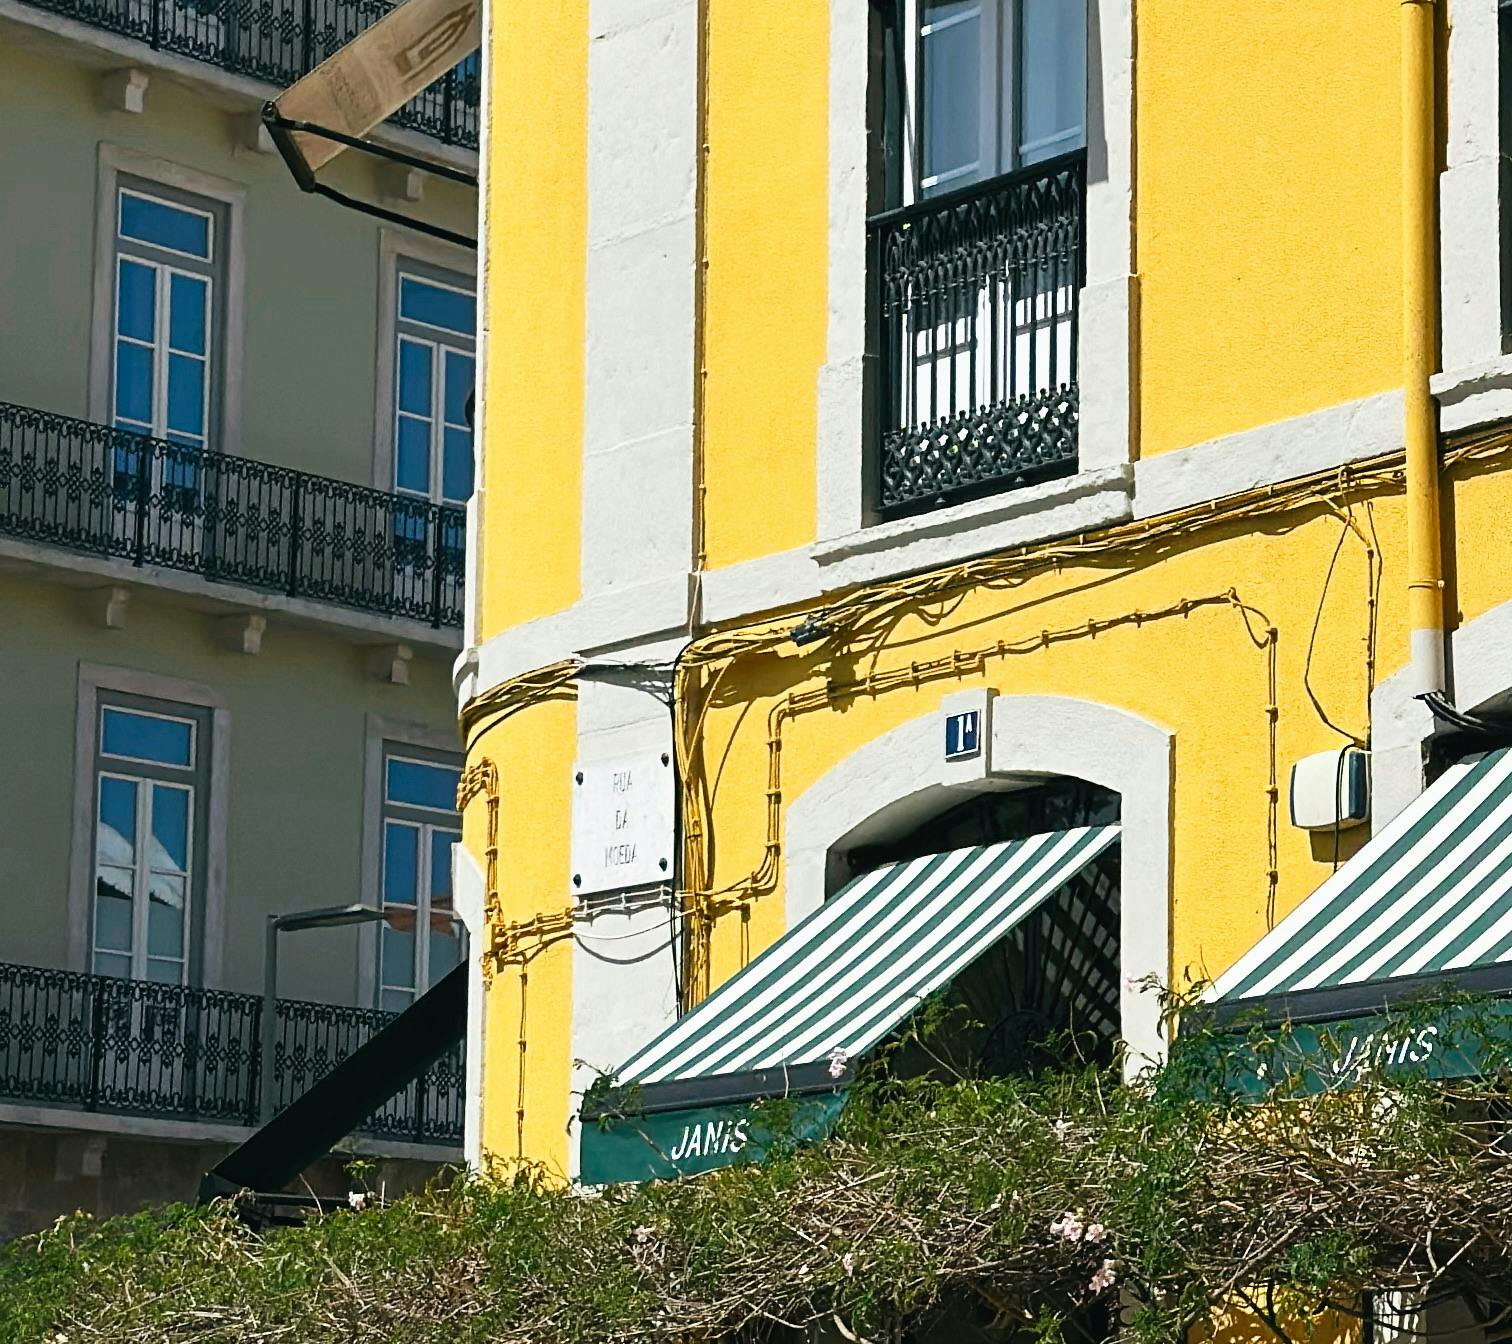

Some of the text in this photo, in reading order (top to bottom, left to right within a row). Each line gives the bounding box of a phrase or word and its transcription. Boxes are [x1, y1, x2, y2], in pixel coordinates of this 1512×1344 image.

[956, 713, 973, 752] 1A
[612, 770, 632, 793] RUA
[615, 808, 628, 830] DA
[604, 843, 637, 868] MOEDA
